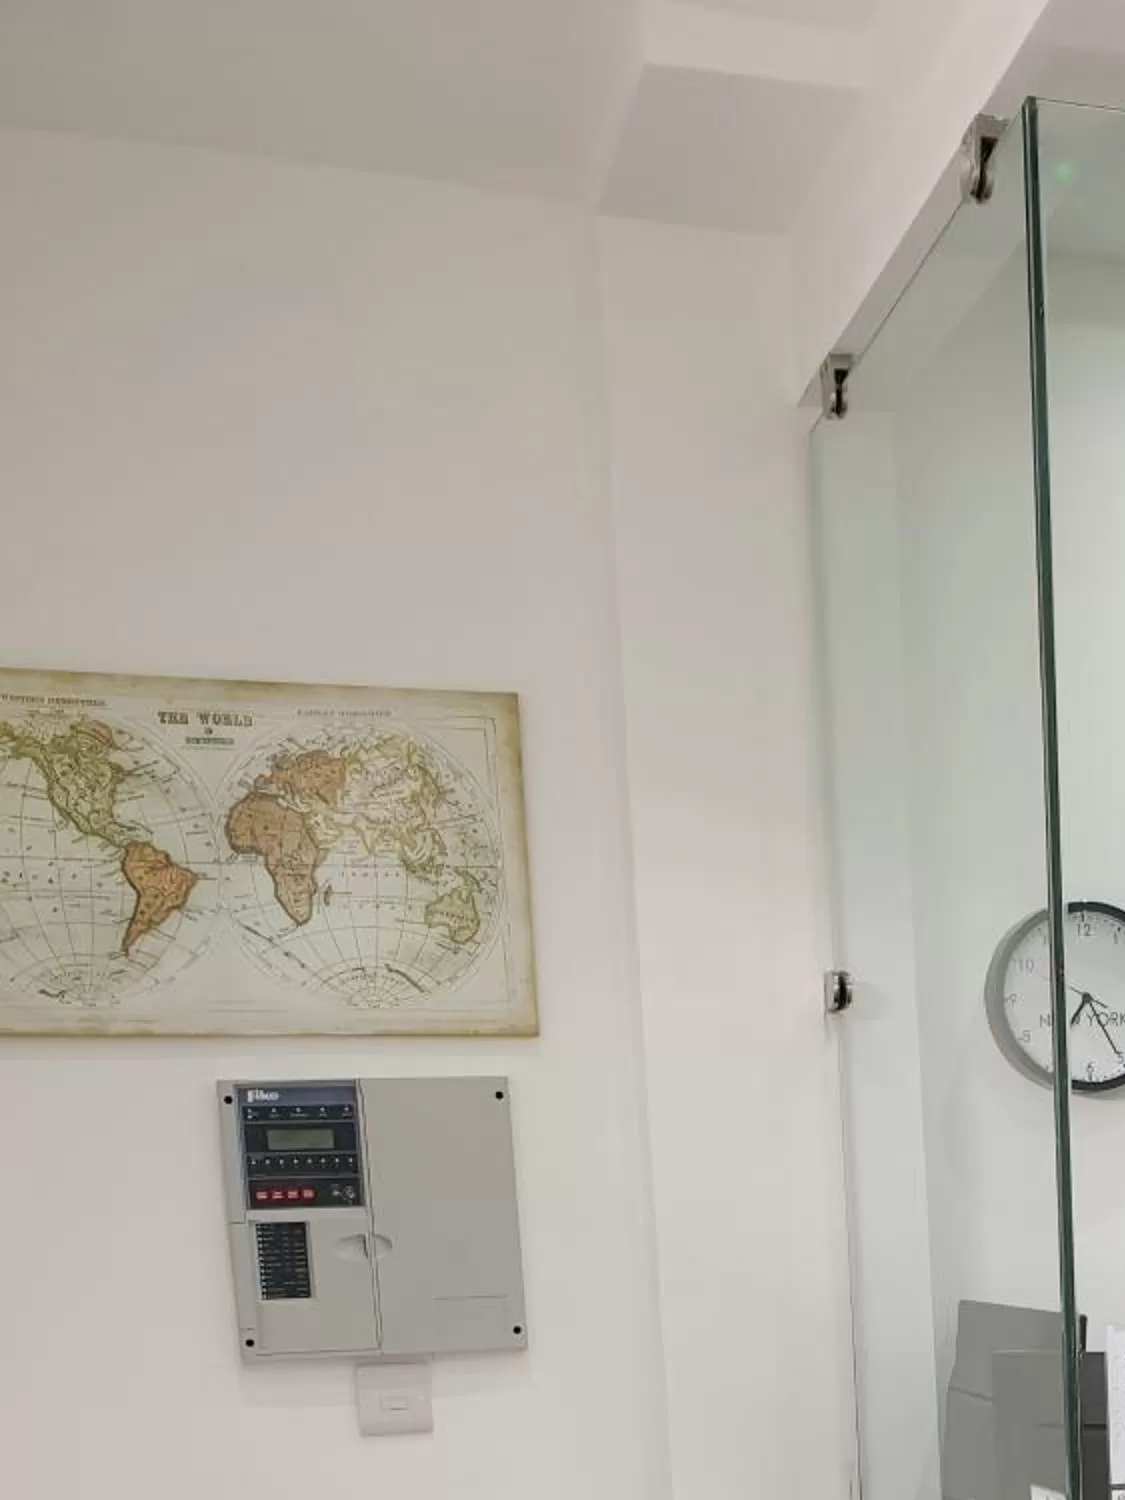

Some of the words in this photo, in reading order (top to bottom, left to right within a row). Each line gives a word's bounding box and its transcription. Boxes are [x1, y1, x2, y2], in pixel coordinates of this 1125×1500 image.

[157, 711, 189, 725] THE
[196, 711, 253, 727] WORLD
[1077, 923, 1093, 937] 12
